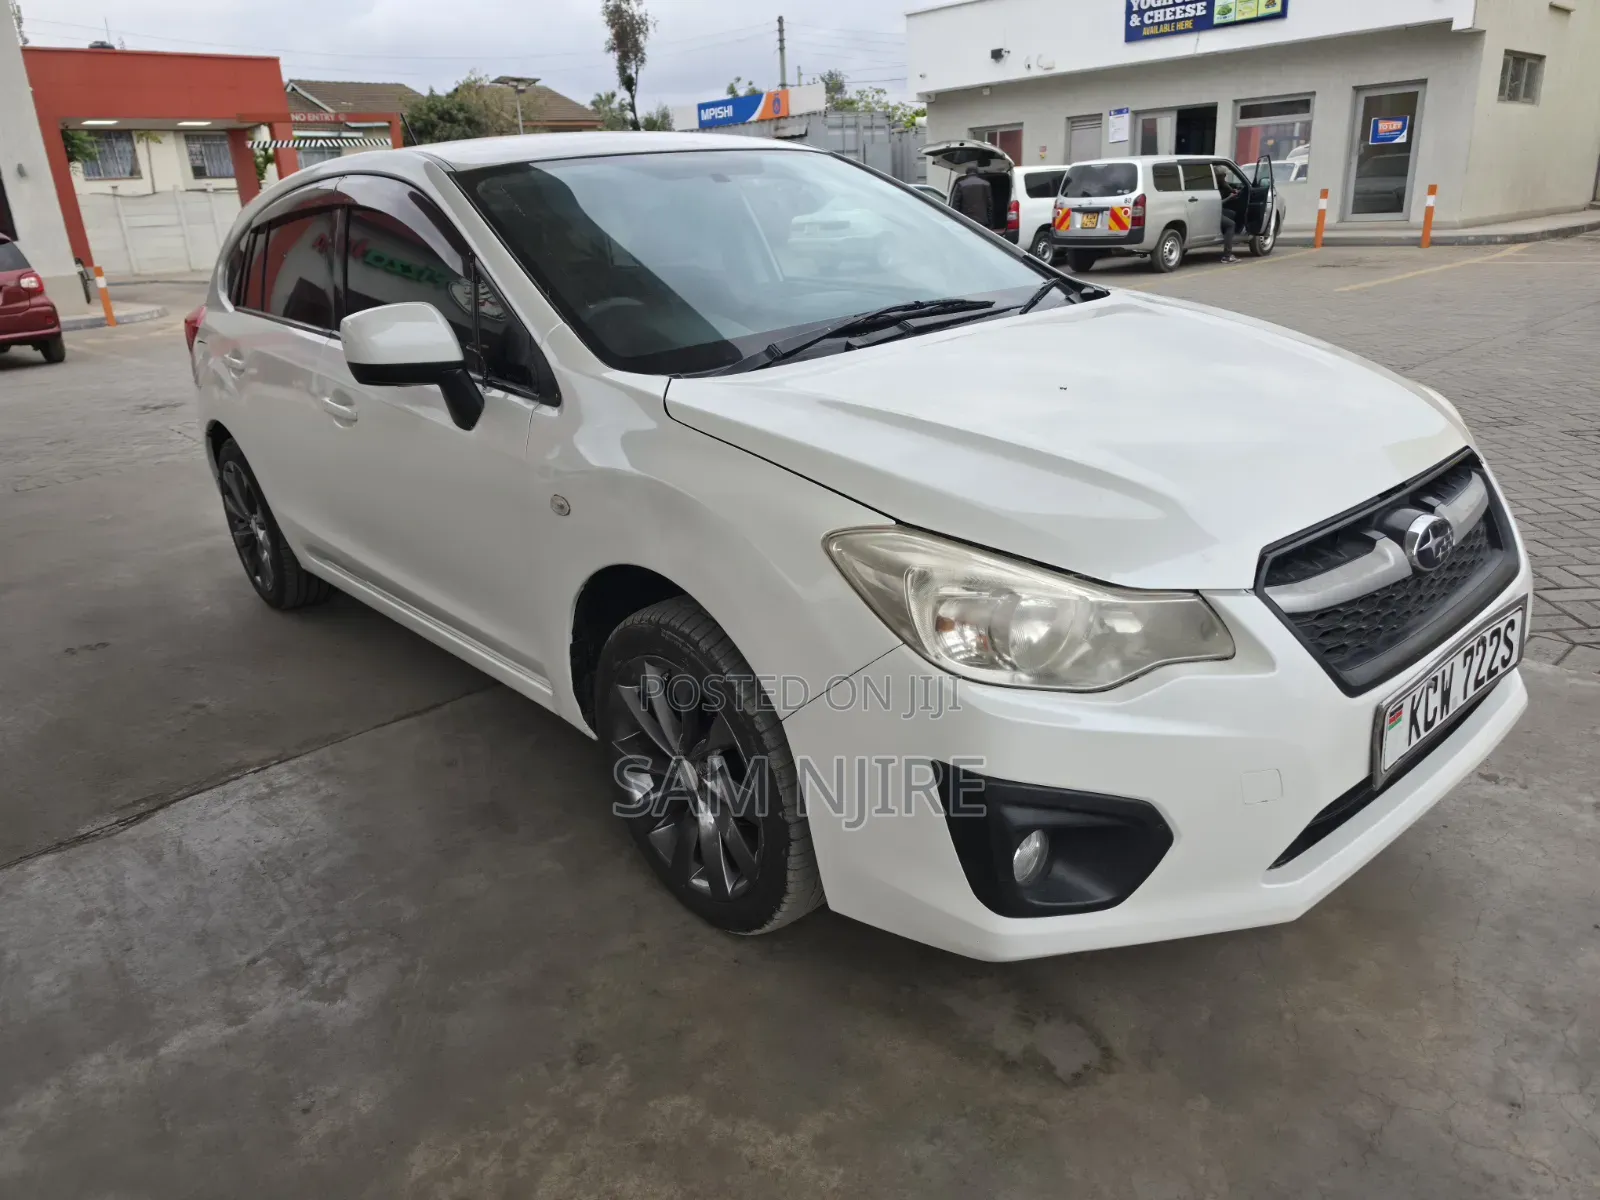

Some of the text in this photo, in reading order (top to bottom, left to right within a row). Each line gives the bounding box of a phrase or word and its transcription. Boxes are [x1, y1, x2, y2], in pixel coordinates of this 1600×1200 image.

[1129, 1, 1207, 27] & CHEESE
[1143, 19, 1194, 36] AVAILABLE HERE
[291, 112, 335, 121] NO ENTRY
[701, 105, 733, 120] MPISHI
[1408, 618, 1515, 747] KCW 722S
